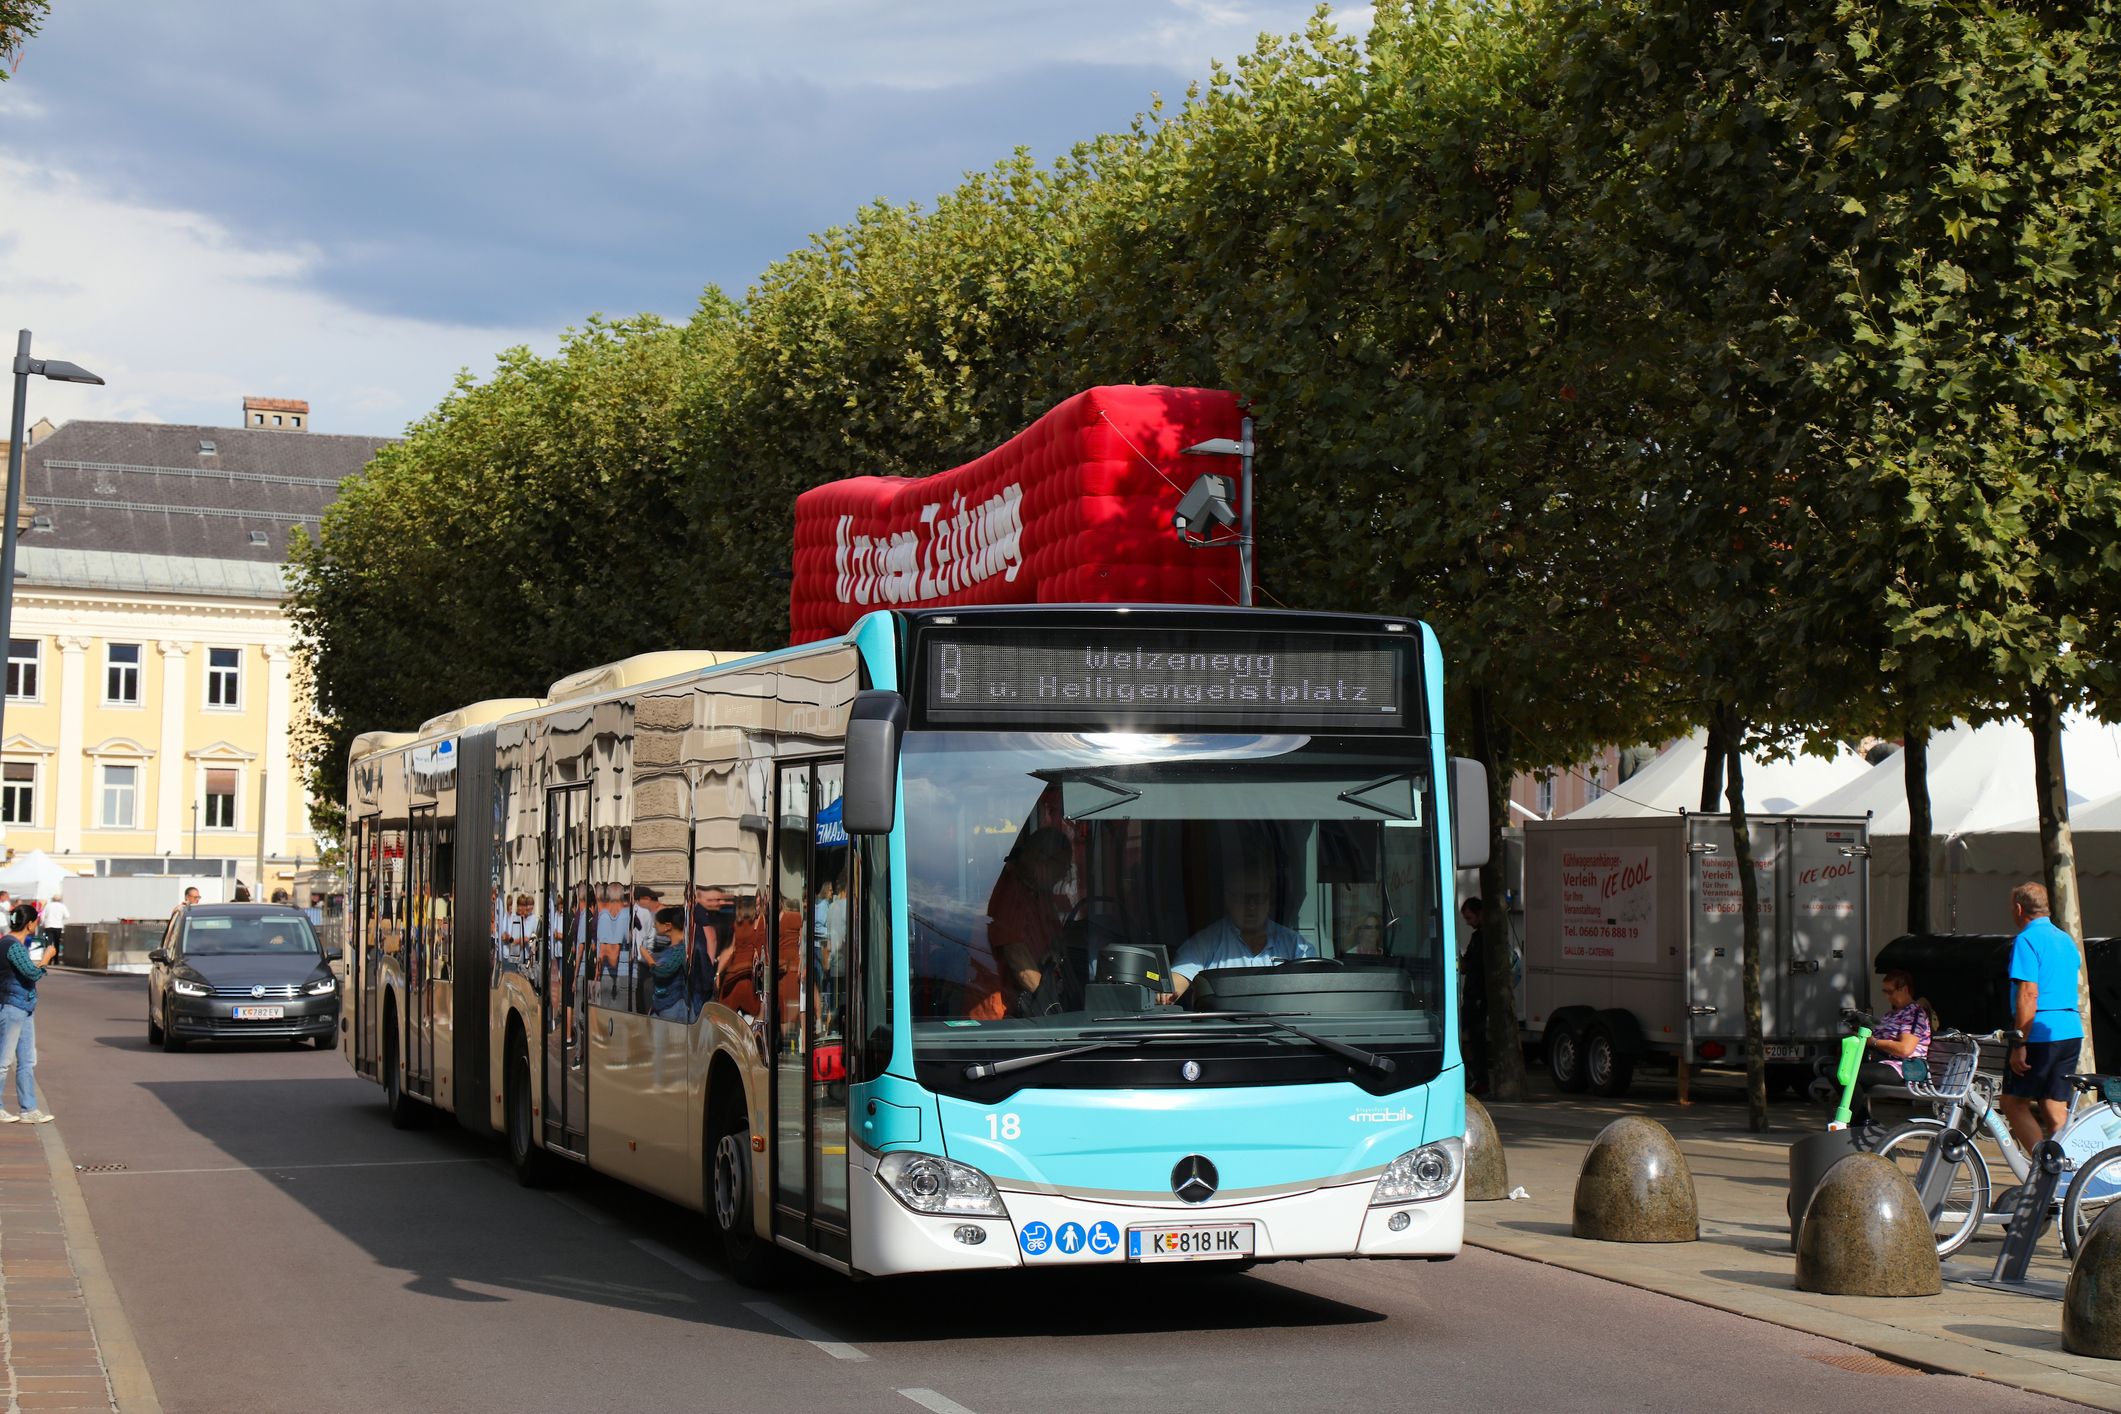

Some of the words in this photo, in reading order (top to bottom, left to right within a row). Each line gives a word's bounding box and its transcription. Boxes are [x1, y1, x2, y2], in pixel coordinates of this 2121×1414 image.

[1086, 646, 1274, 677] Welzenegg
[940, 643, 961, 699] B
[1039, 678, 1368, 704] Heiligengeistplatz
[1563, 872, 1597, 887] Verleih
[1601, 872, 1619, 901] ICE
[1621, 856, 1652, 891] COOL
[1702, 870, 1734, 880] Verleih
[1799, 868, 1819, 886] ICE
[1821, 861, 1855, 879] COOL
[1717, 904, 1736, 913] 0660
[1763, 904, 1773, 913] 19
[1564, 926, 1578, 937] Tel.
[1579, 926, 1599, 938] 0660
[1599, 926, 1610, 938] 76
[1611, 927, 1627, 938] 888
[1628, 928, 1639, 939] 19
[1588, 947, 1615, 958] CATERING
[242, 1008, 248, 1016] K
[253, 1008, 268, 1016] 782
[269, 1008, 279, 1016] EV
[1357, 1107, 1406, 1122] mobil
[985, 1113, 1021, 1140] 18
[1154, 1234, 1165, 1254] K
[1180, 1232, 1211, 1252] 818
[1217, 1230, 1239, 1250] HK
